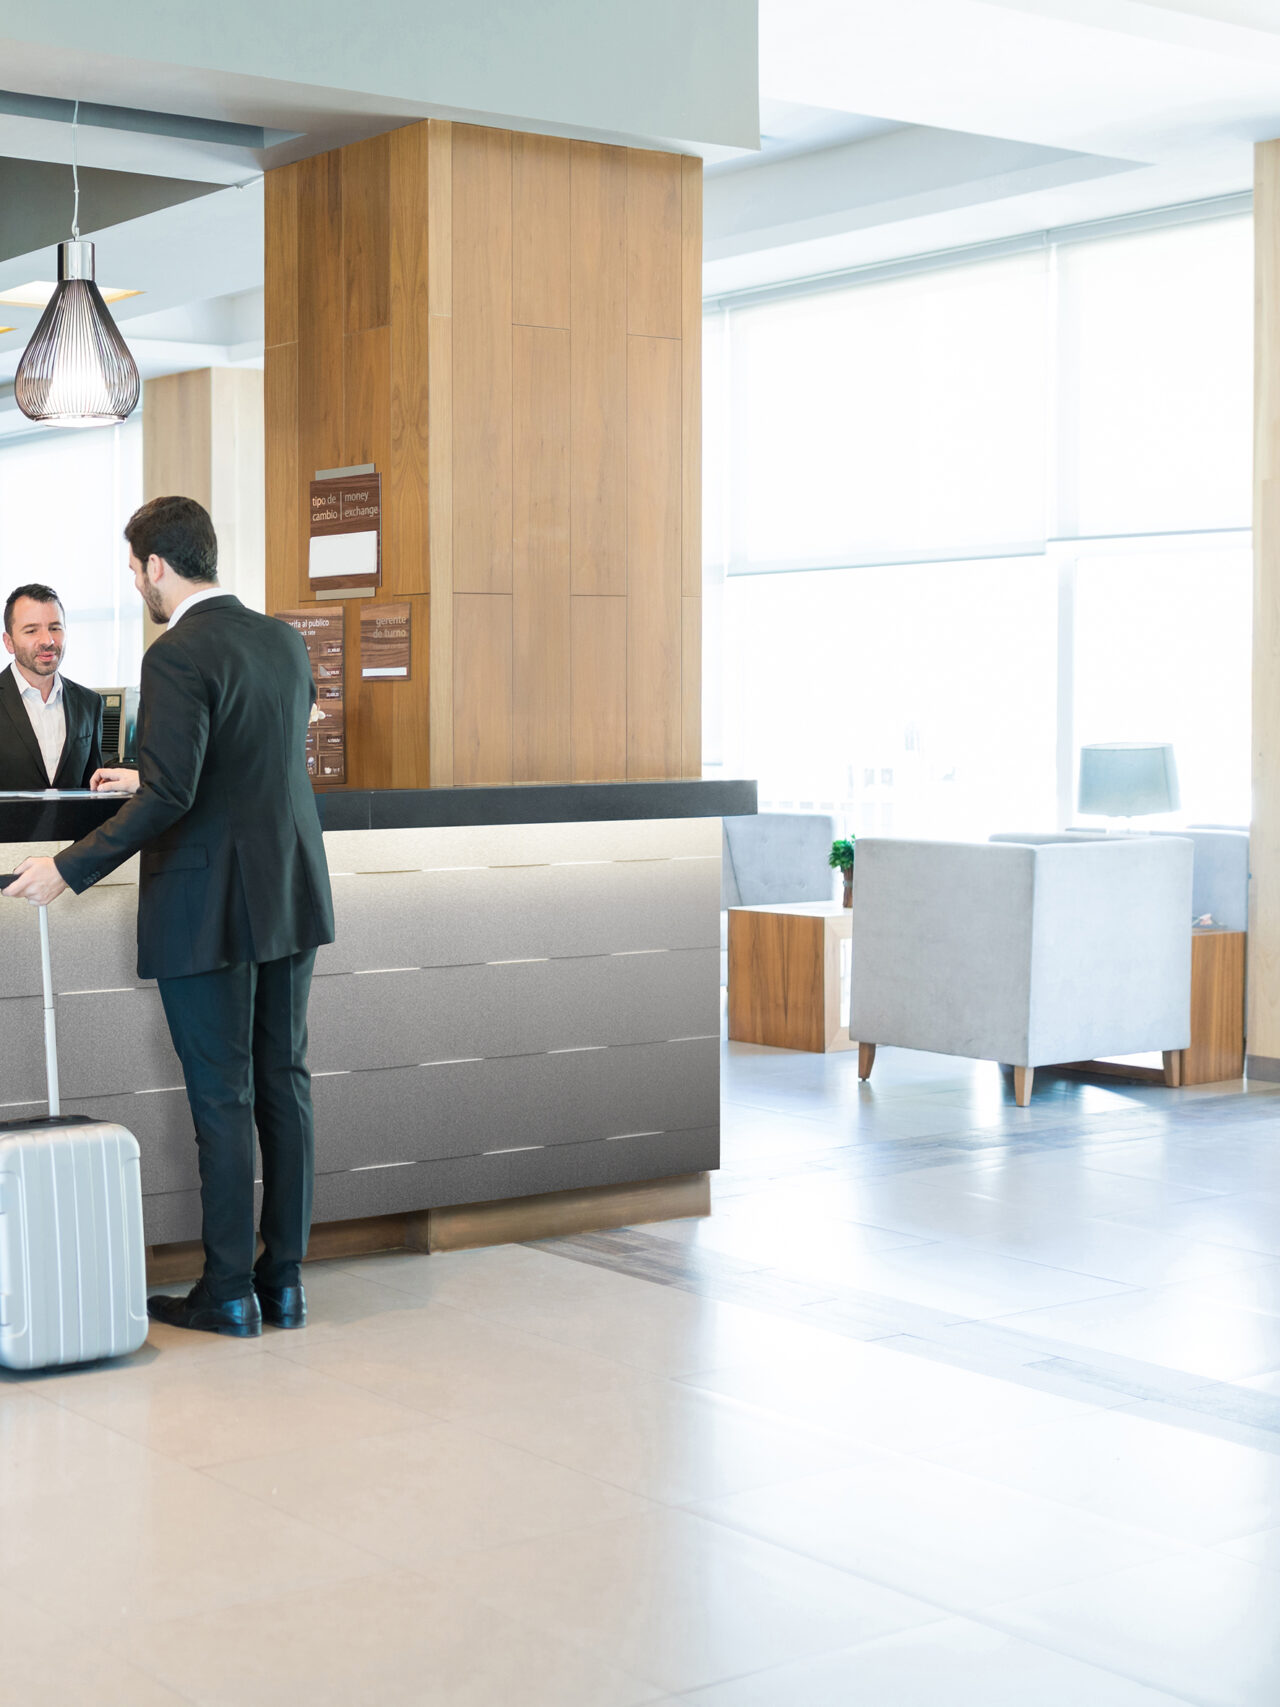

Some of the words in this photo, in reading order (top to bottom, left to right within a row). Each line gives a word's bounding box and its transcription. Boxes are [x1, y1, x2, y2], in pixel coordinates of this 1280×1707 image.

[312, 496, 326, 508] tipo
[327, 494, 337, 504] de
[344, 491, 369, 502] money
[312, 509, 338, 522] cambio
[344, 505, 378, 518] exchange
[302, 619, 308, 627] al
[375, 616, 407, 628] gerente
[373, 628, 383, 638] de
